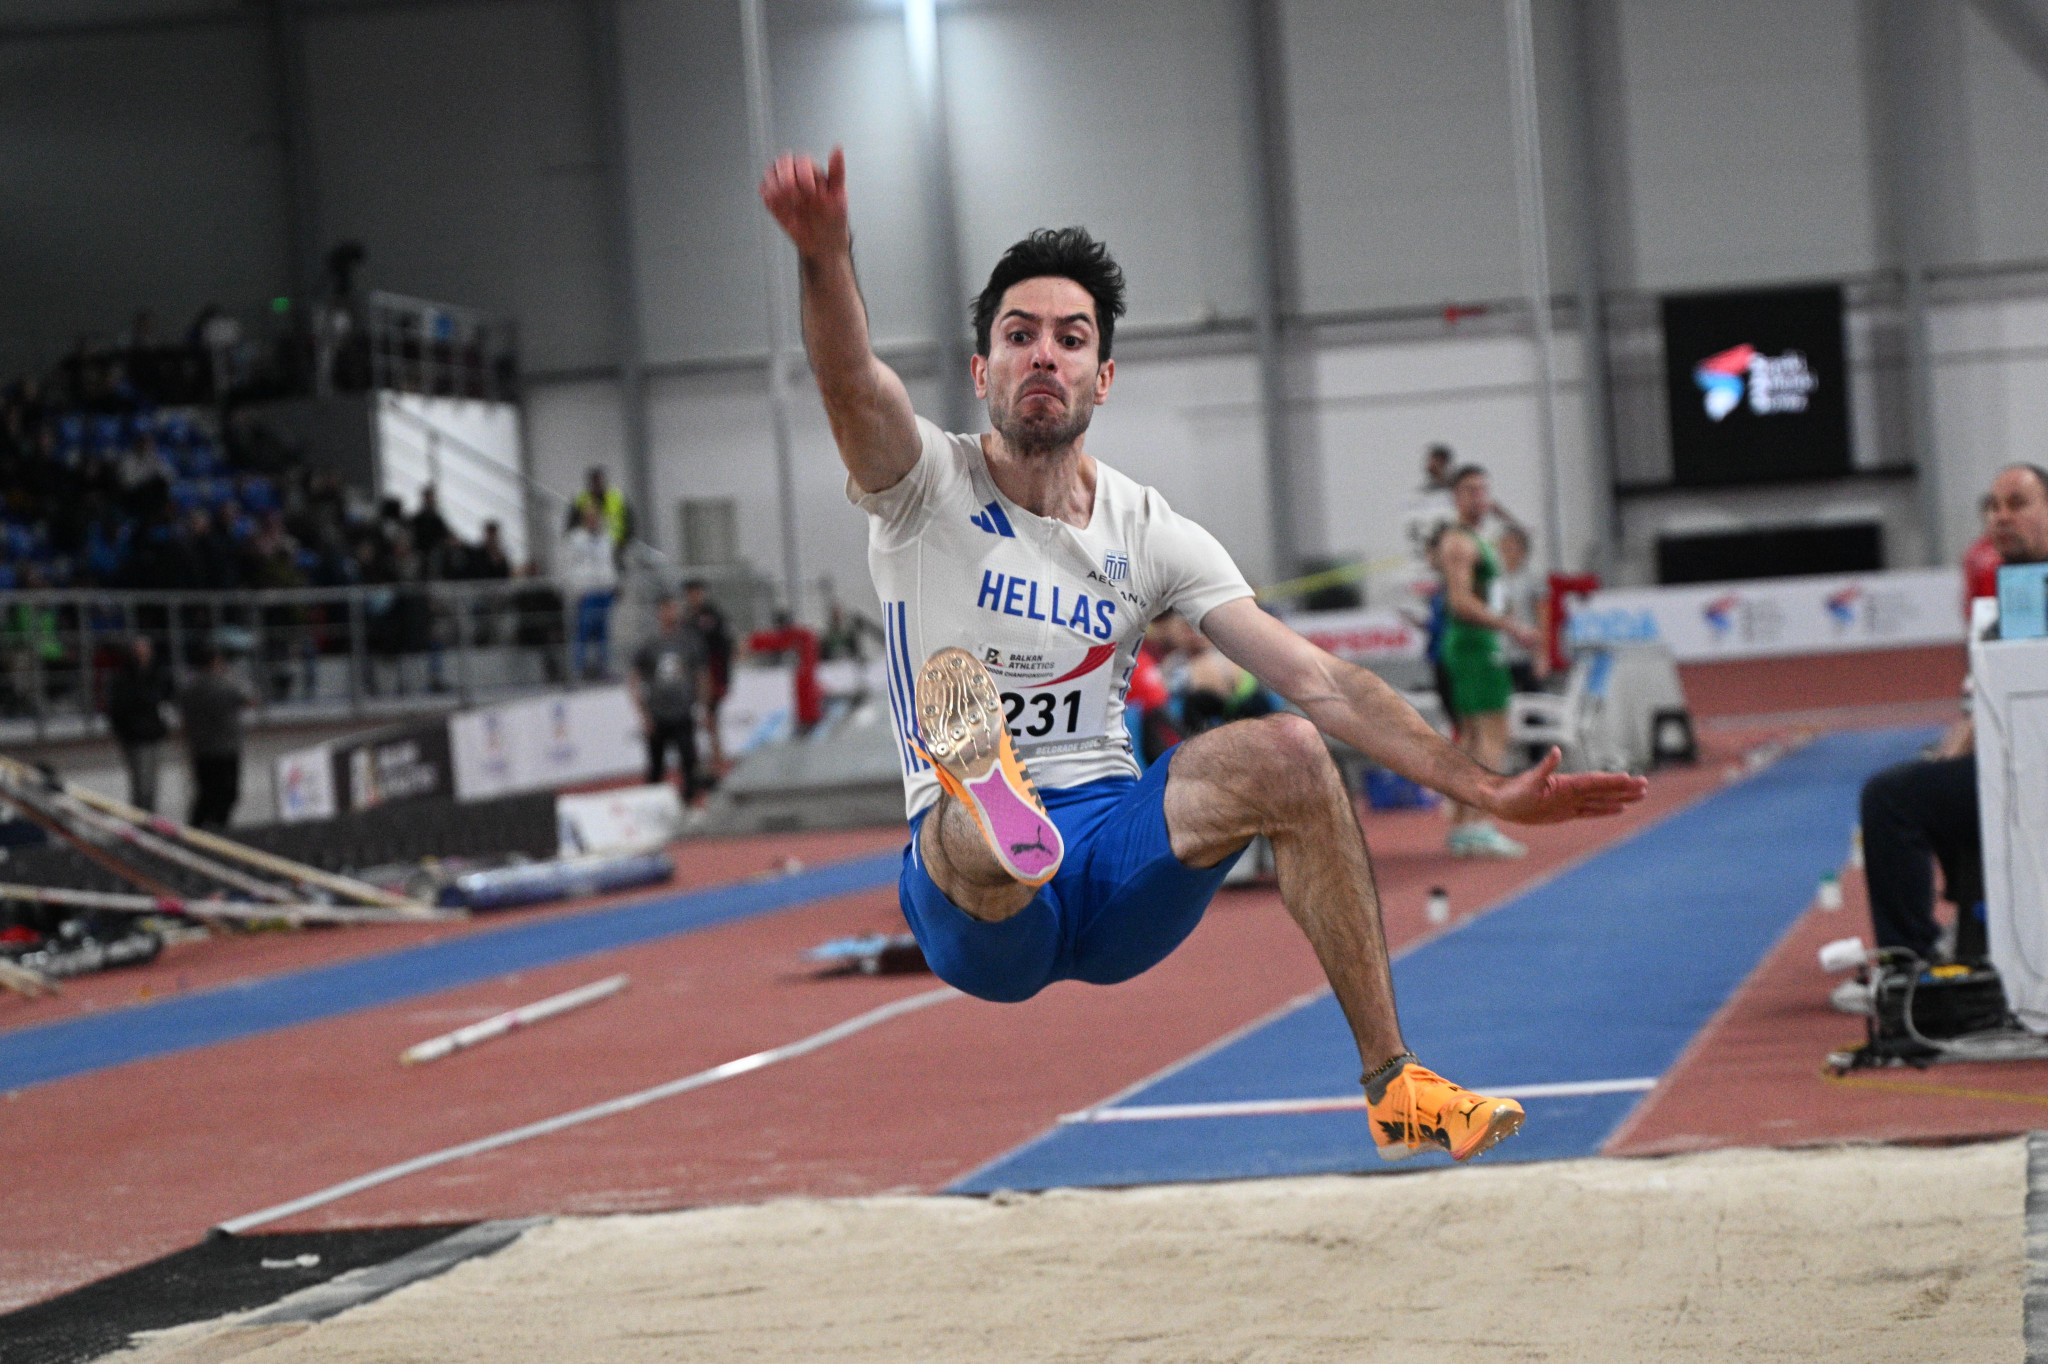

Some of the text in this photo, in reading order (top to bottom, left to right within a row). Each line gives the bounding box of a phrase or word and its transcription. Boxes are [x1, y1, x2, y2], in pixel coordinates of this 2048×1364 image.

[977, 569, 1116, 640] HELLAS
[1009, 654, 1043, 662] BALKAN
[1008, 662, 1055, 670] ATHLETICS
[1004, 671, 1054, 679] CHAMPIONSHIPS
[1000, 690, 1082, 737] 231
